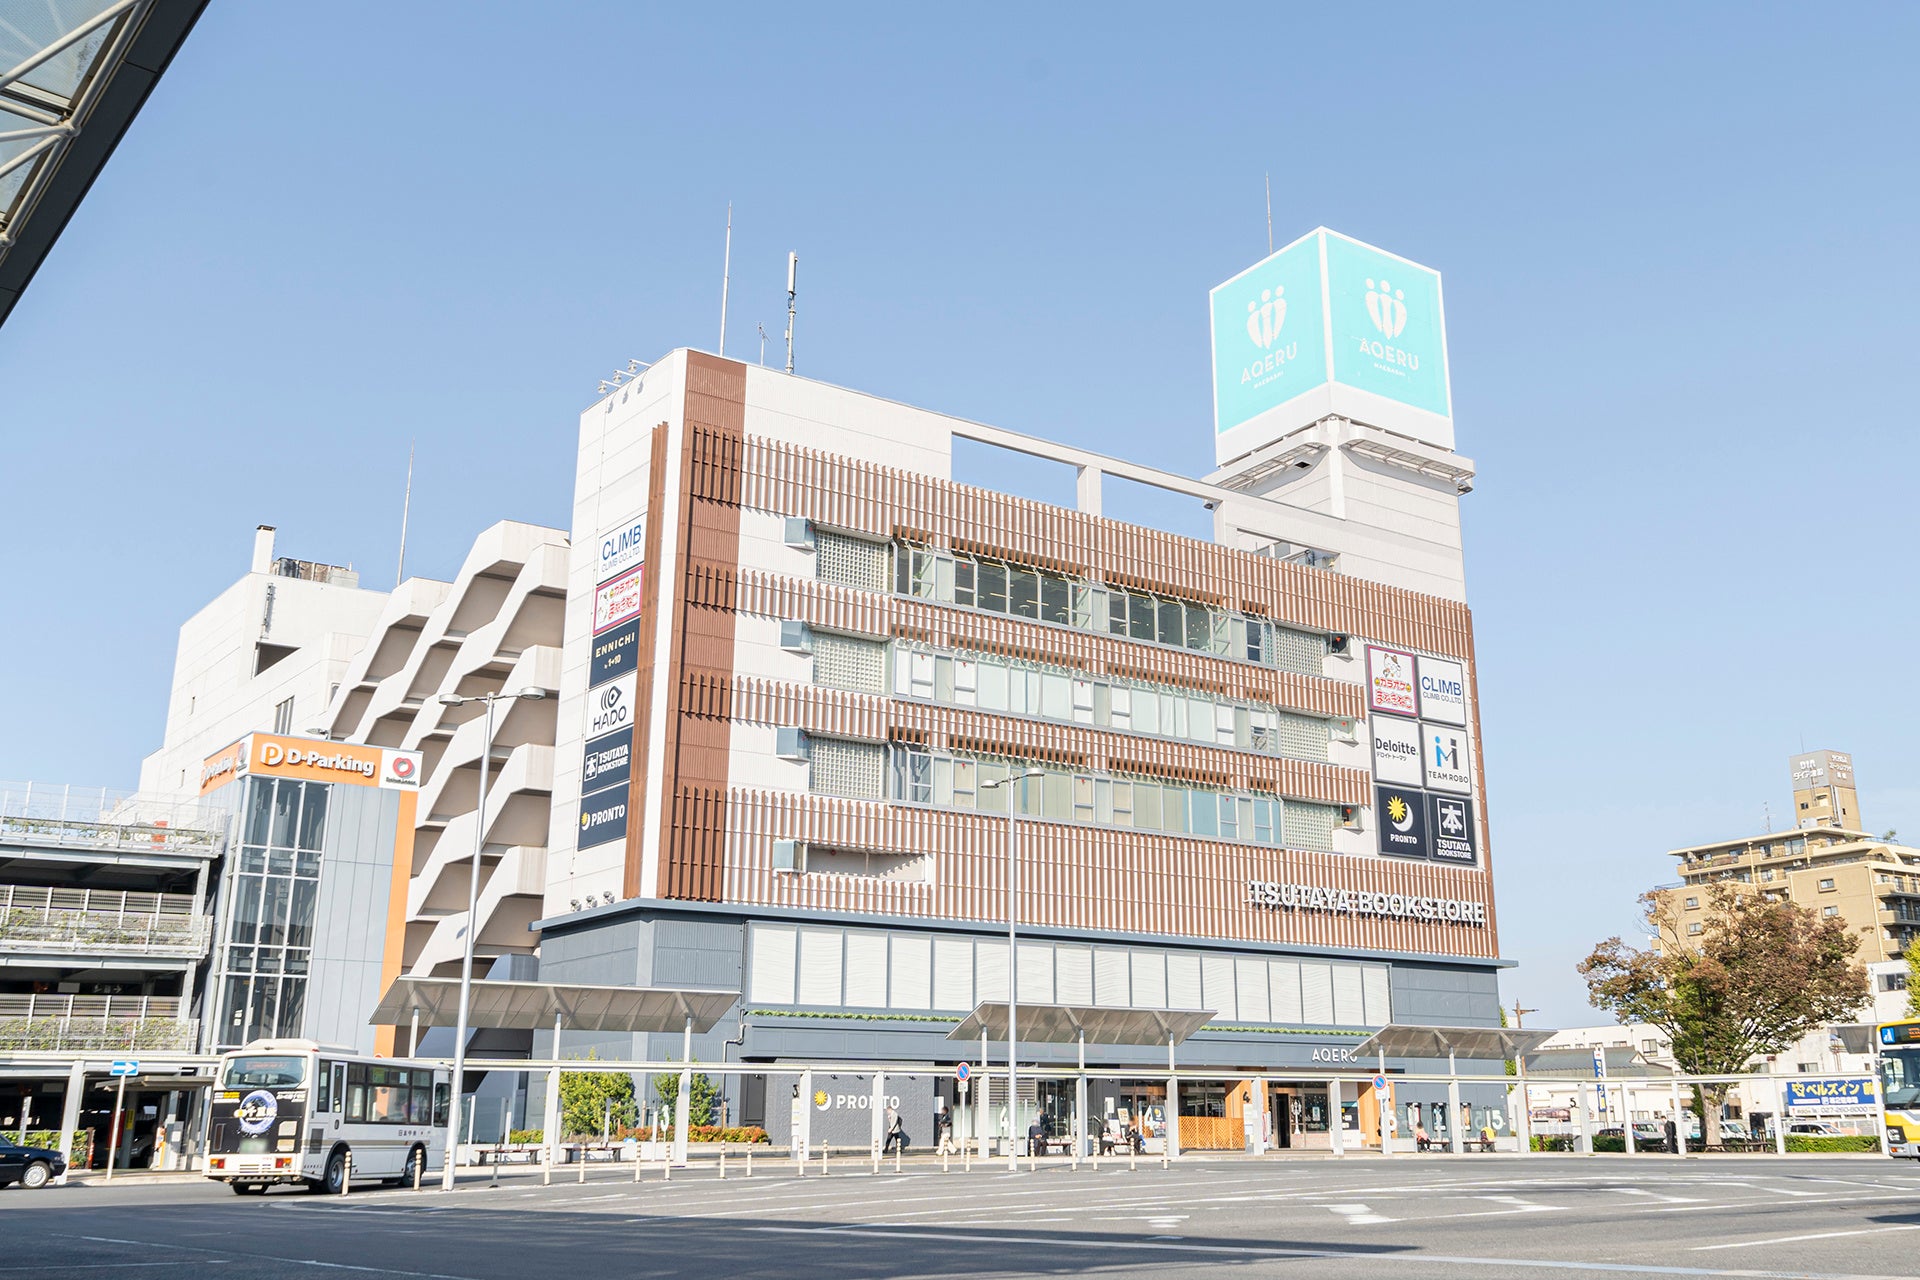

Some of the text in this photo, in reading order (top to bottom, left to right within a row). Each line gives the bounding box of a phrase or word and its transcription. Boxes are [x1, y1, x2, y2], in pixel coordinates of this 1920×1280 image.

[602, 524, 642, 561] CLIMB
[595, 631, 636, 658] ENNICHI
[1379, 677, 1407, 691] カラオケ
[1421, 676, 1463, 696] CLIMB
[1422, 691, 1440, 701] CLIMB
[593, 705, 627, 733] HADO
[287, 749, 375, 777] D-Parking
[598, 743, 629, 764] TSUTAYA
[597, 755, 629, 774] BOOKSTORE
[1428, 770, 1469, 784] TEAM ROBO
[590, 804, 626, 827] PRONTO
[1390, 833, 1418, 845] PRONTO
[1436, 838, 1472, 852] TSUTAYA
[1437, 848, 1472, 859] BOOKSTORE
[1249, 880, 1487, 923] TSUTAYA BOOKSTORE
[836, 1094, 900, 1109] PROTO
